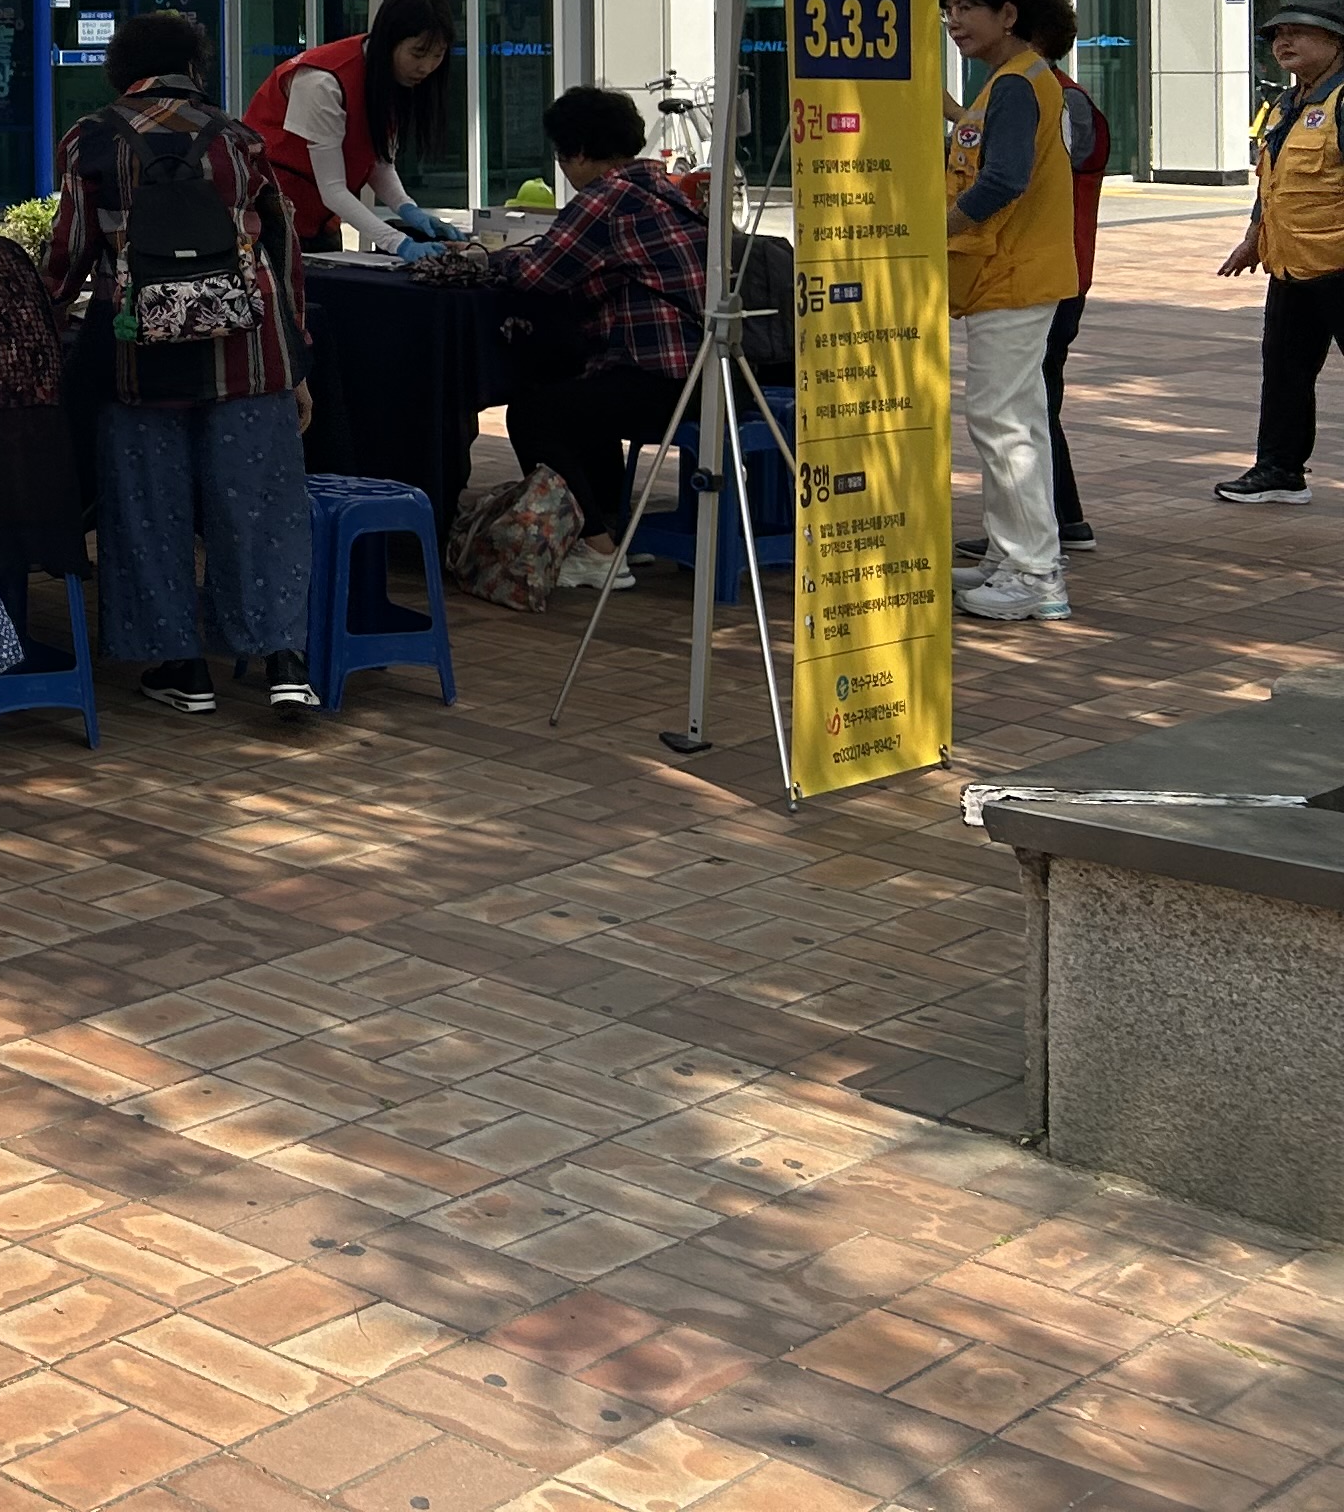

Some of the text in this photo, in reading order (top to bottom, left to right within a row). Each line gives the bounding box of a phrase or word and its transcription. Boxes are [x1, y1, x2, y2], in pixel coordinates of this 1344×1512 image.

[793, 98, 823, 143] 3권
[797, 272, 826, 317] 3금
[800, 462, 829, 508] 3행
[850, 670, 894, 693] 연수구보건소
[843, 700, 906, 729] 연수구치매안심센터
